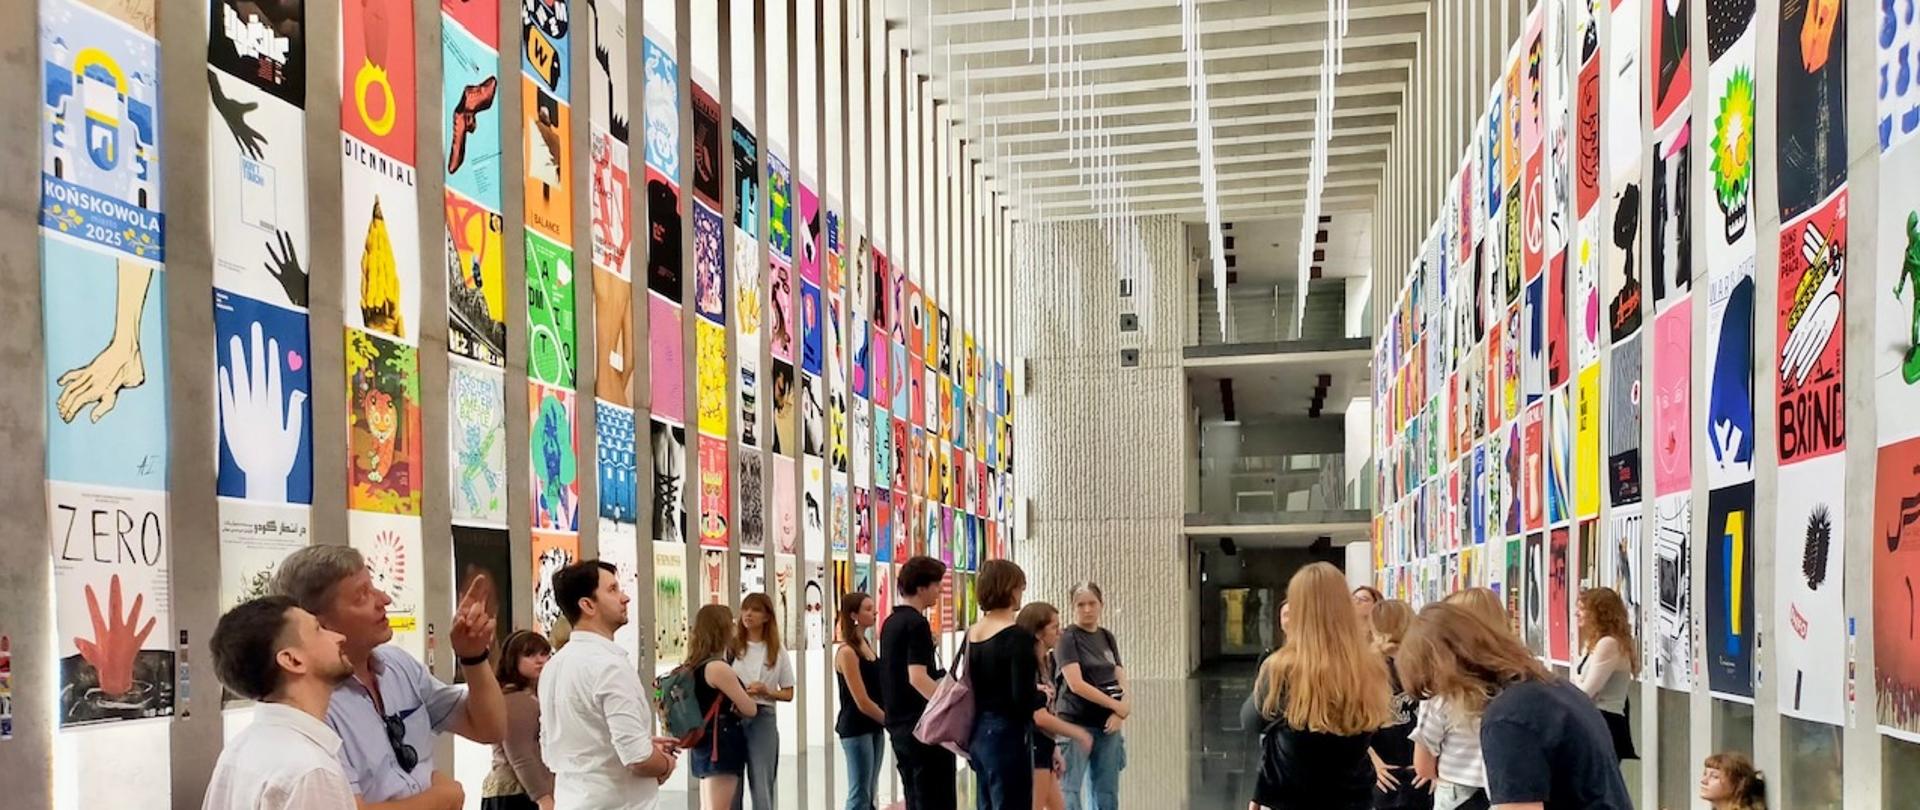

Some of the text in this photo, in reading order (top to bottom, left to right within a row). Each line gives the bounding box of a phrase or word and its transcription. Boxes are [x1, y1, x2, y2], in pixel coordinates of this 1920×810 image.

[344, 138, 414, 187] BIENNIAL
[44, 179, 161, 232] KOŃSKOWOLA
[533, 213, 560, 233] BALANCE
[86, 223, 122, 246] 2025
[58, 503, 162, 566] ZERO
